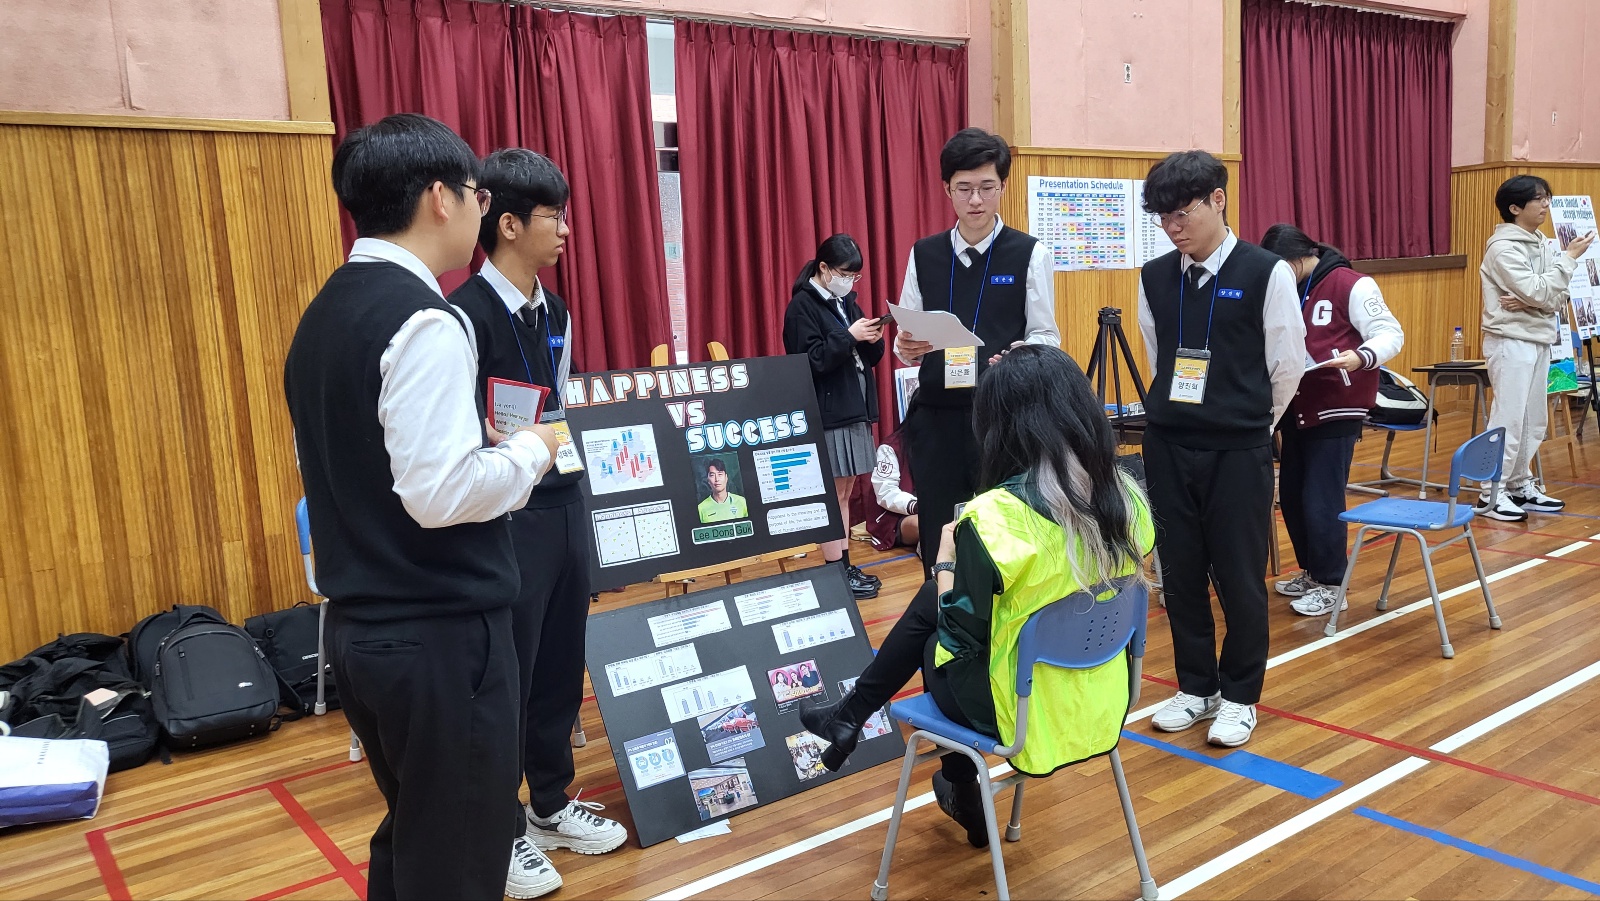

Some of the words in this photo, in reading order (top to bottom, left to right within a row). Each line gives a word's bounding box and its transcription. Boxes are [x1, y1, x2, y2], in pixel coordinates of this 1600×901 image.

[1039, 178, 1089, 190] Presentation
[1091, 180, 1124, 190] Schedule
[1311, 299, 1333, 326] G
[566, 363, 750, 408] HAPPINESS
[665, 400, 707, 428] VS
[686, 410, 809, 453] SUCCESS
[694, 528, 711, 542] Lee
[712, 525, 735, 542] Dong
[736, 523, 752, 537] Guk
